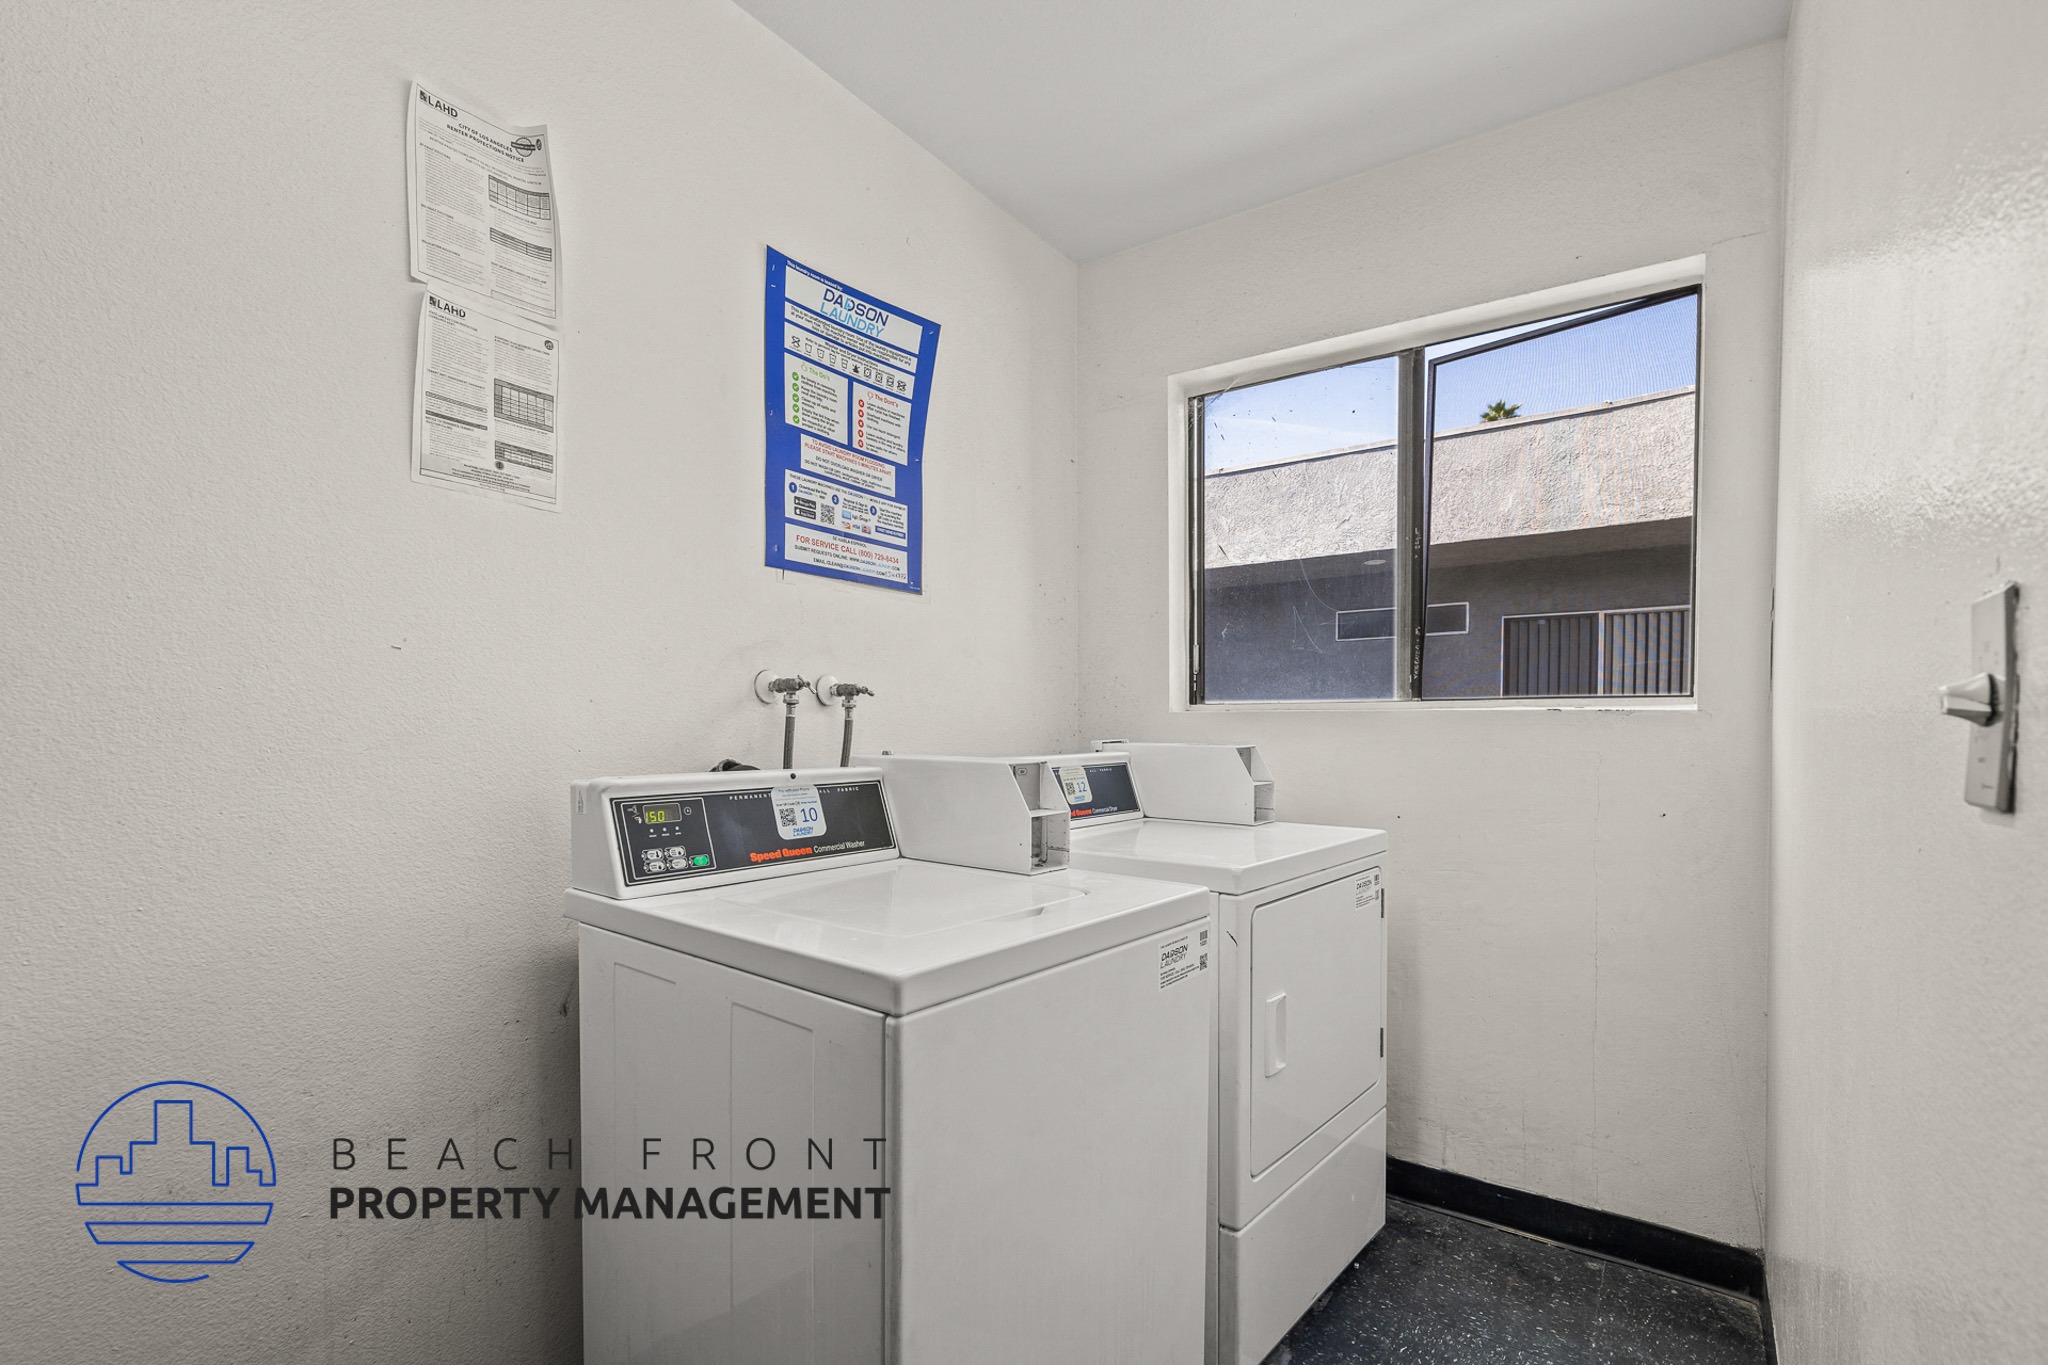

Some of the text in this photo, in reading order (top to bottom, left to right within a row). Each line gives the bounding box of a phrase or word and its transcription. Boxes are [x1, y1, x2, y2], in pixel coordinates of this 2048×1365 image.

[428, 95, 459, 118] LAHD
[447, 124, 525, 163] RENTER PROTECTIONS NOTICE
[458, 123, 471, 132] CITY
[479, 132, 489, 142] LOS
[489, 138, 513, 153] ANGELES
[437, 299, 466, 318] LAHD
[823, 288, 889, 327] DADSON
[819, 302, 885, 338] LAUNDRY
[883, 397, 898, 408] Dont's
[796, 534, 810, 544] FOR
[811, 537, 838, 551] SERVICE
[840, 544, 856, 555] CALL
[858, 548, 873, 559] (800)
[1076, 781, 1087, 793] 12
[800, 807, 818, 823] 10
[750, 840, 865, 863] Speed Queen Commercial Washer
[1161, 943, 1188, 962] DADSON
